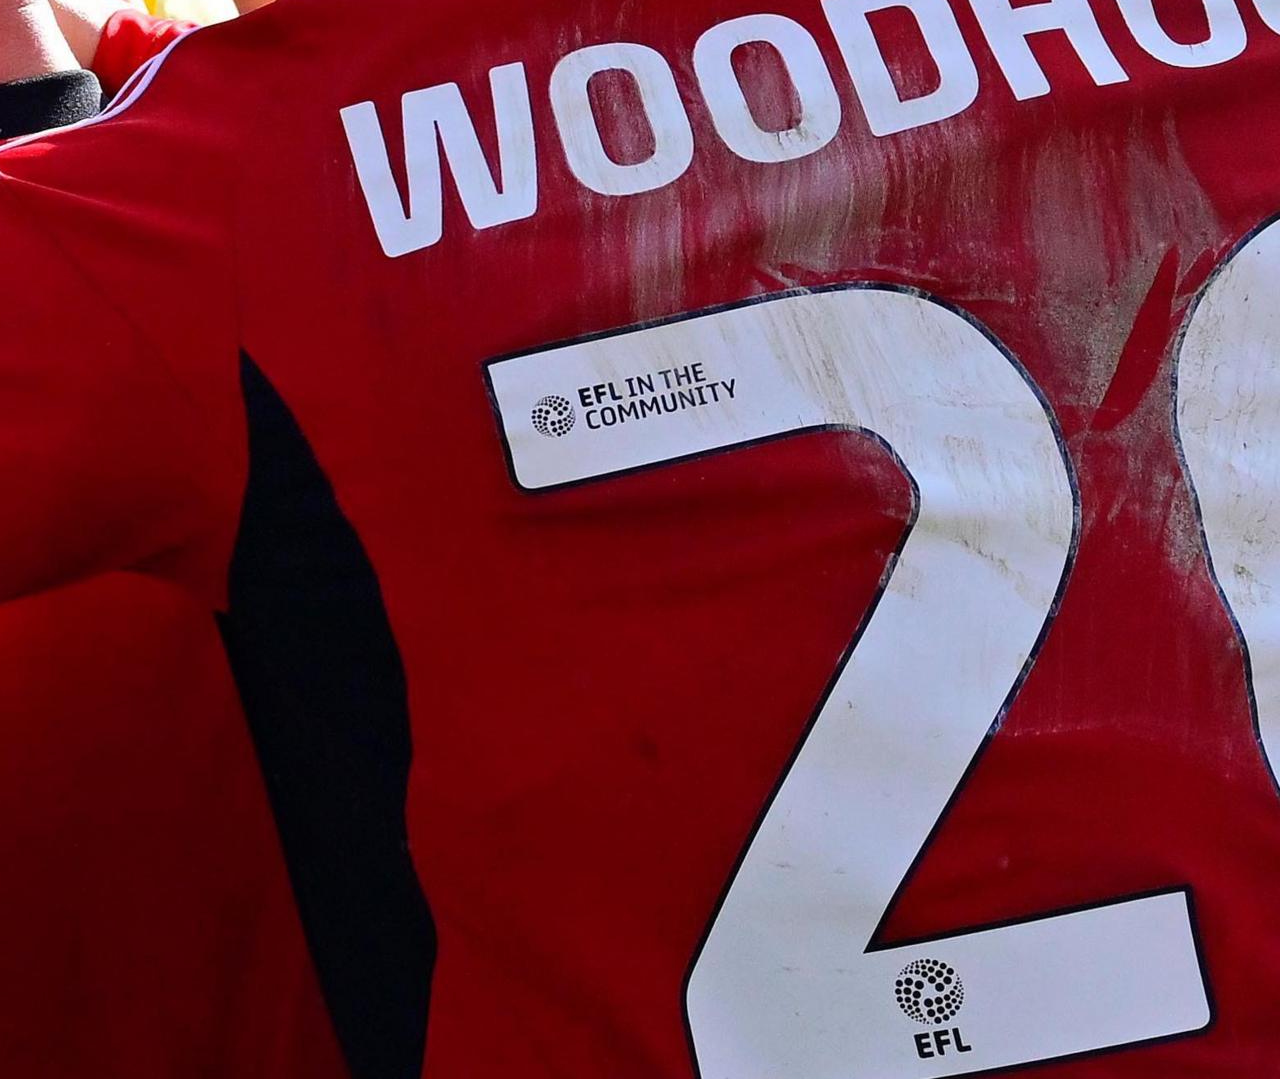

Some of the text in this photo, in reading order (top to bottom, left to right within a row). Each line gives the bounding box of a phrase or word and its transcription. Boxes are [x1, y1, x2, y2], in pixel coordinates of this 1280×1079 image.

[577, 362, 707, 408] EFL IN THE
[585, 378, 736, 430] COMMUNITY
[913, 1026, 973, 1059] EFL
